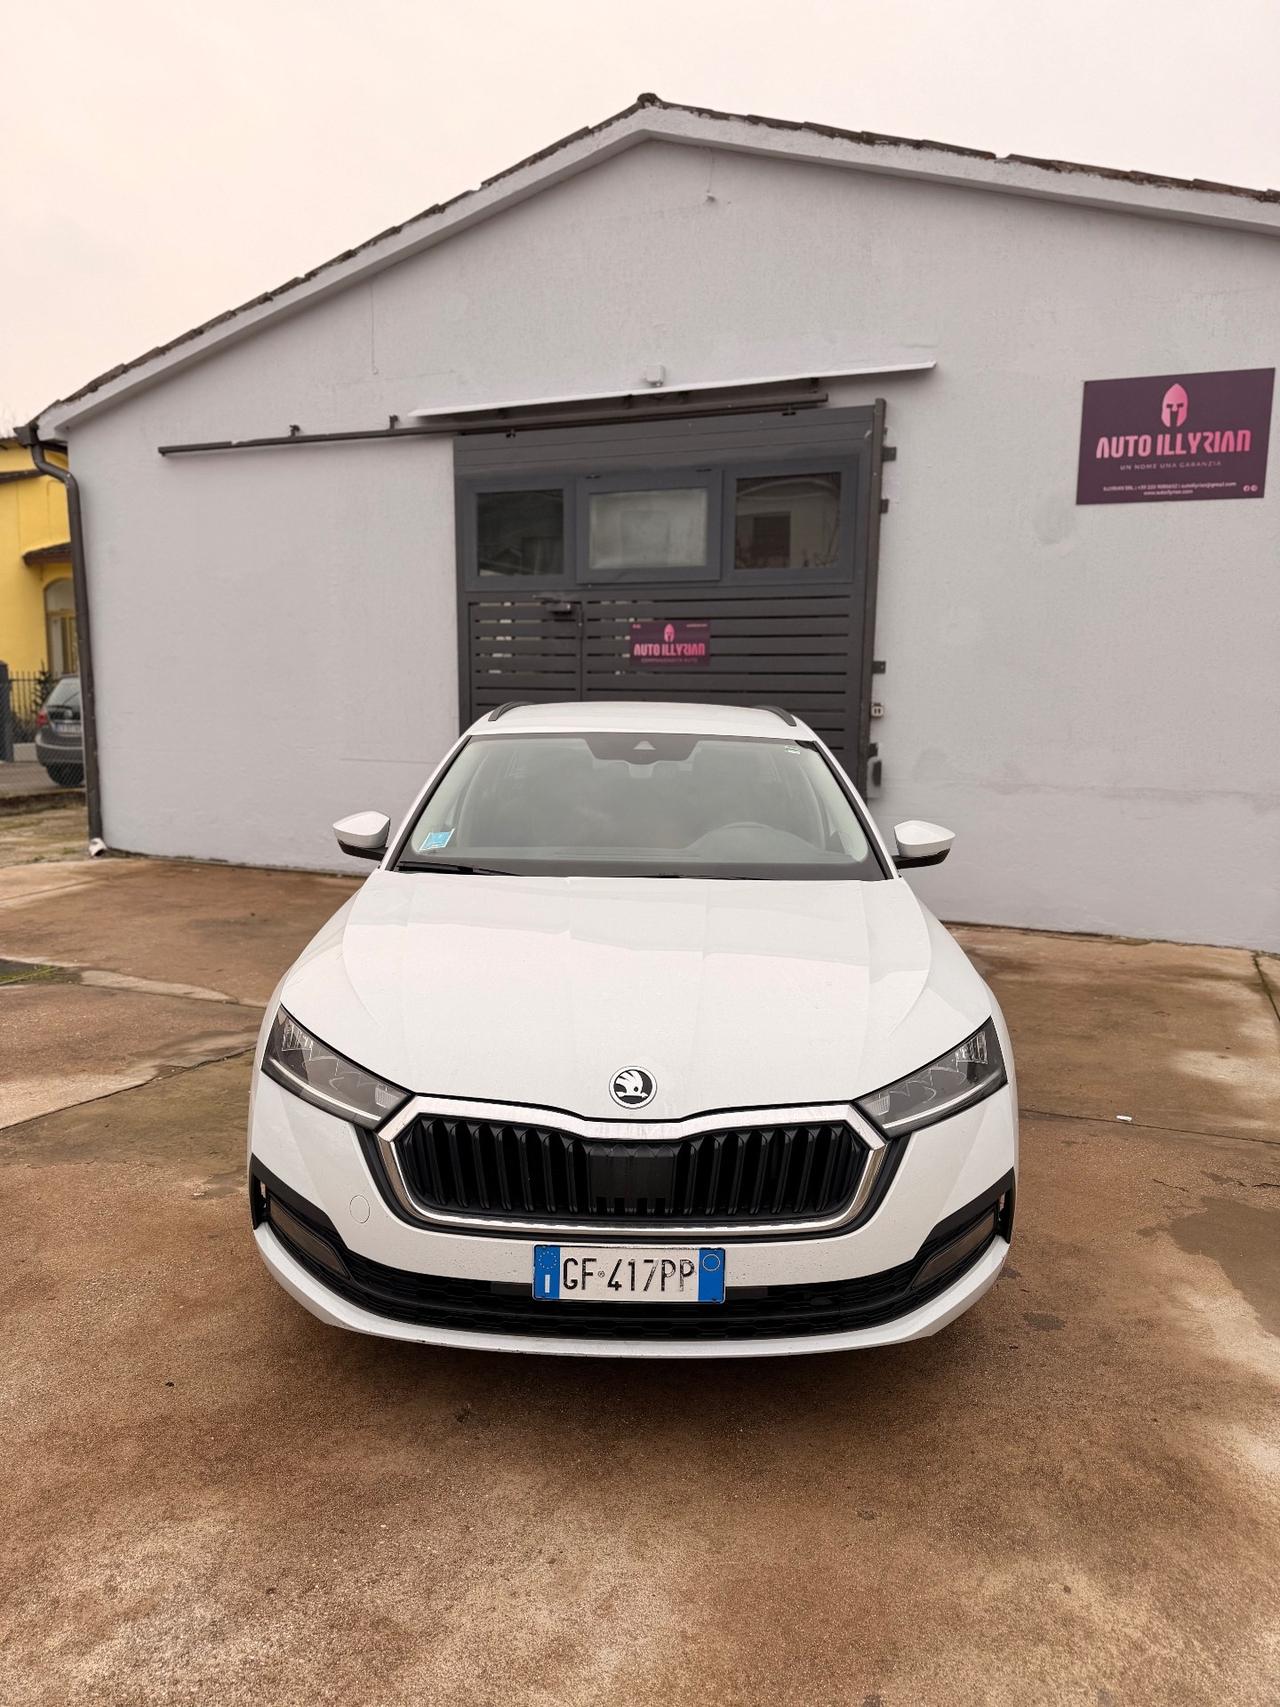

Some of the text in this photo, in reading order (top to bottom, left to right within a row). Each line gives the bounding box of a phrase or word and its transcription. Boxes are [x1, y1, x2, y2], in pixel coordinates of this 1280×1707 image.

[1096, 429, 1251, 459] AUTO ILLYRIAN
[1120, 464, 1132, 472] UN
[1134, 462, 1157, 471] NOME
[1160, 461, 1178, 470] UNA
[634, 643, 705, 656] AUTO ILLYRIAN
